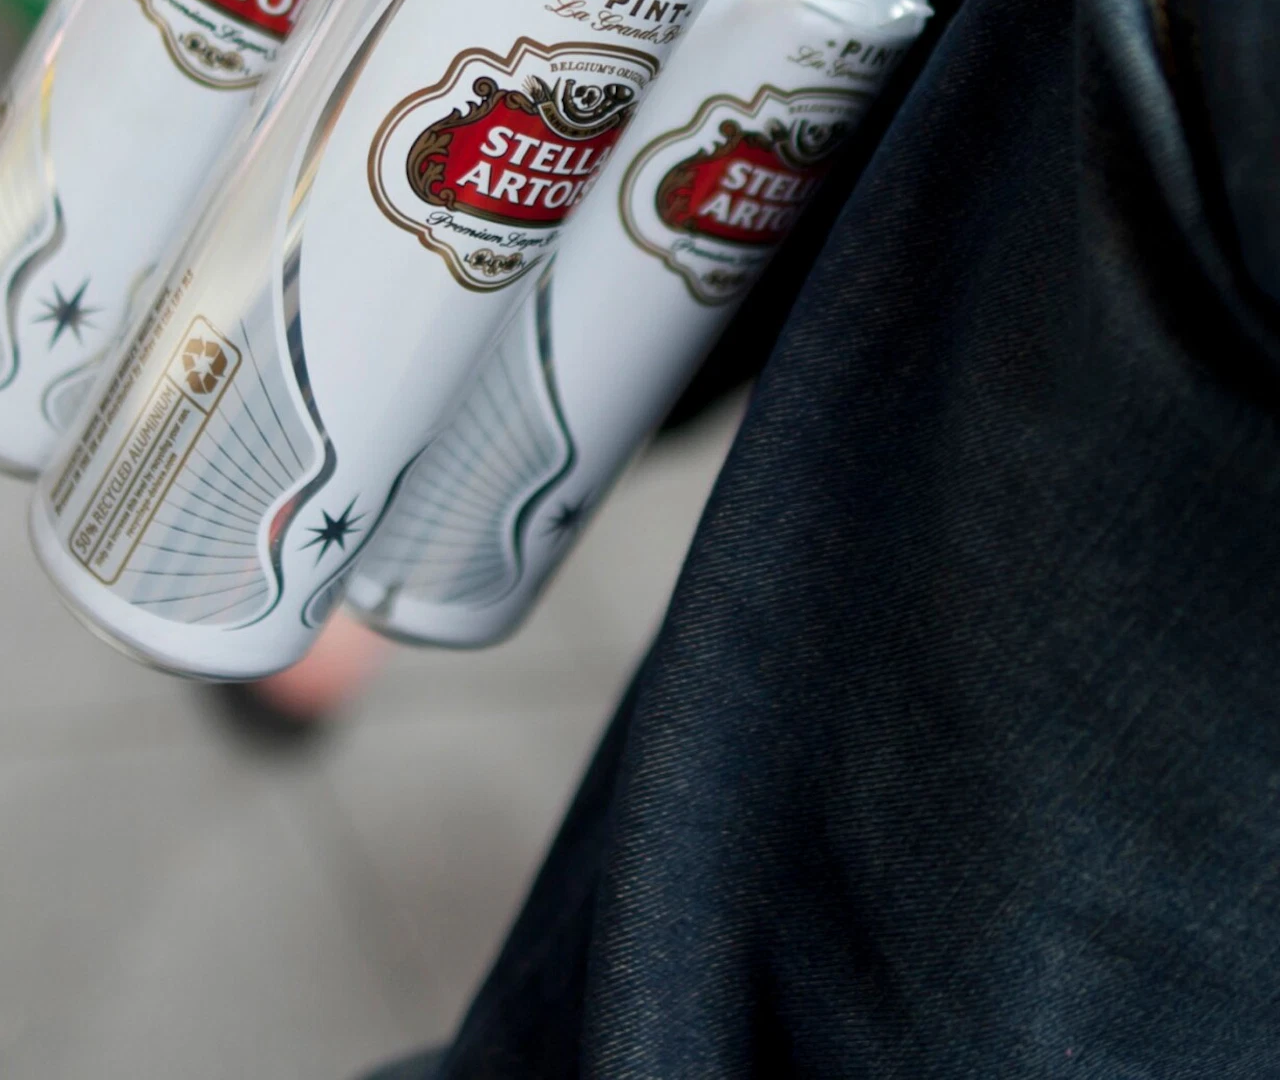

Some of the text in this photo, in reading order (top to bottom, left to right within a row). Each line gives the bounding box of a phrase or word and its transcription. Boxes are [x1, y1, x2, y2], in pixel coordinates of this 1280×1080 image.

[591, 10, 661, 42] Grande
[550, 61, 616, 75] BELGIUM'S
[840, 39, 898, 67] PIN
[722, 162, 813, 203] STEL
[425, 211, 504, 244] Premium
[90, 458, 135, 525] RECYCLED
[124, 383, 178, 465] ALUMINIUM
